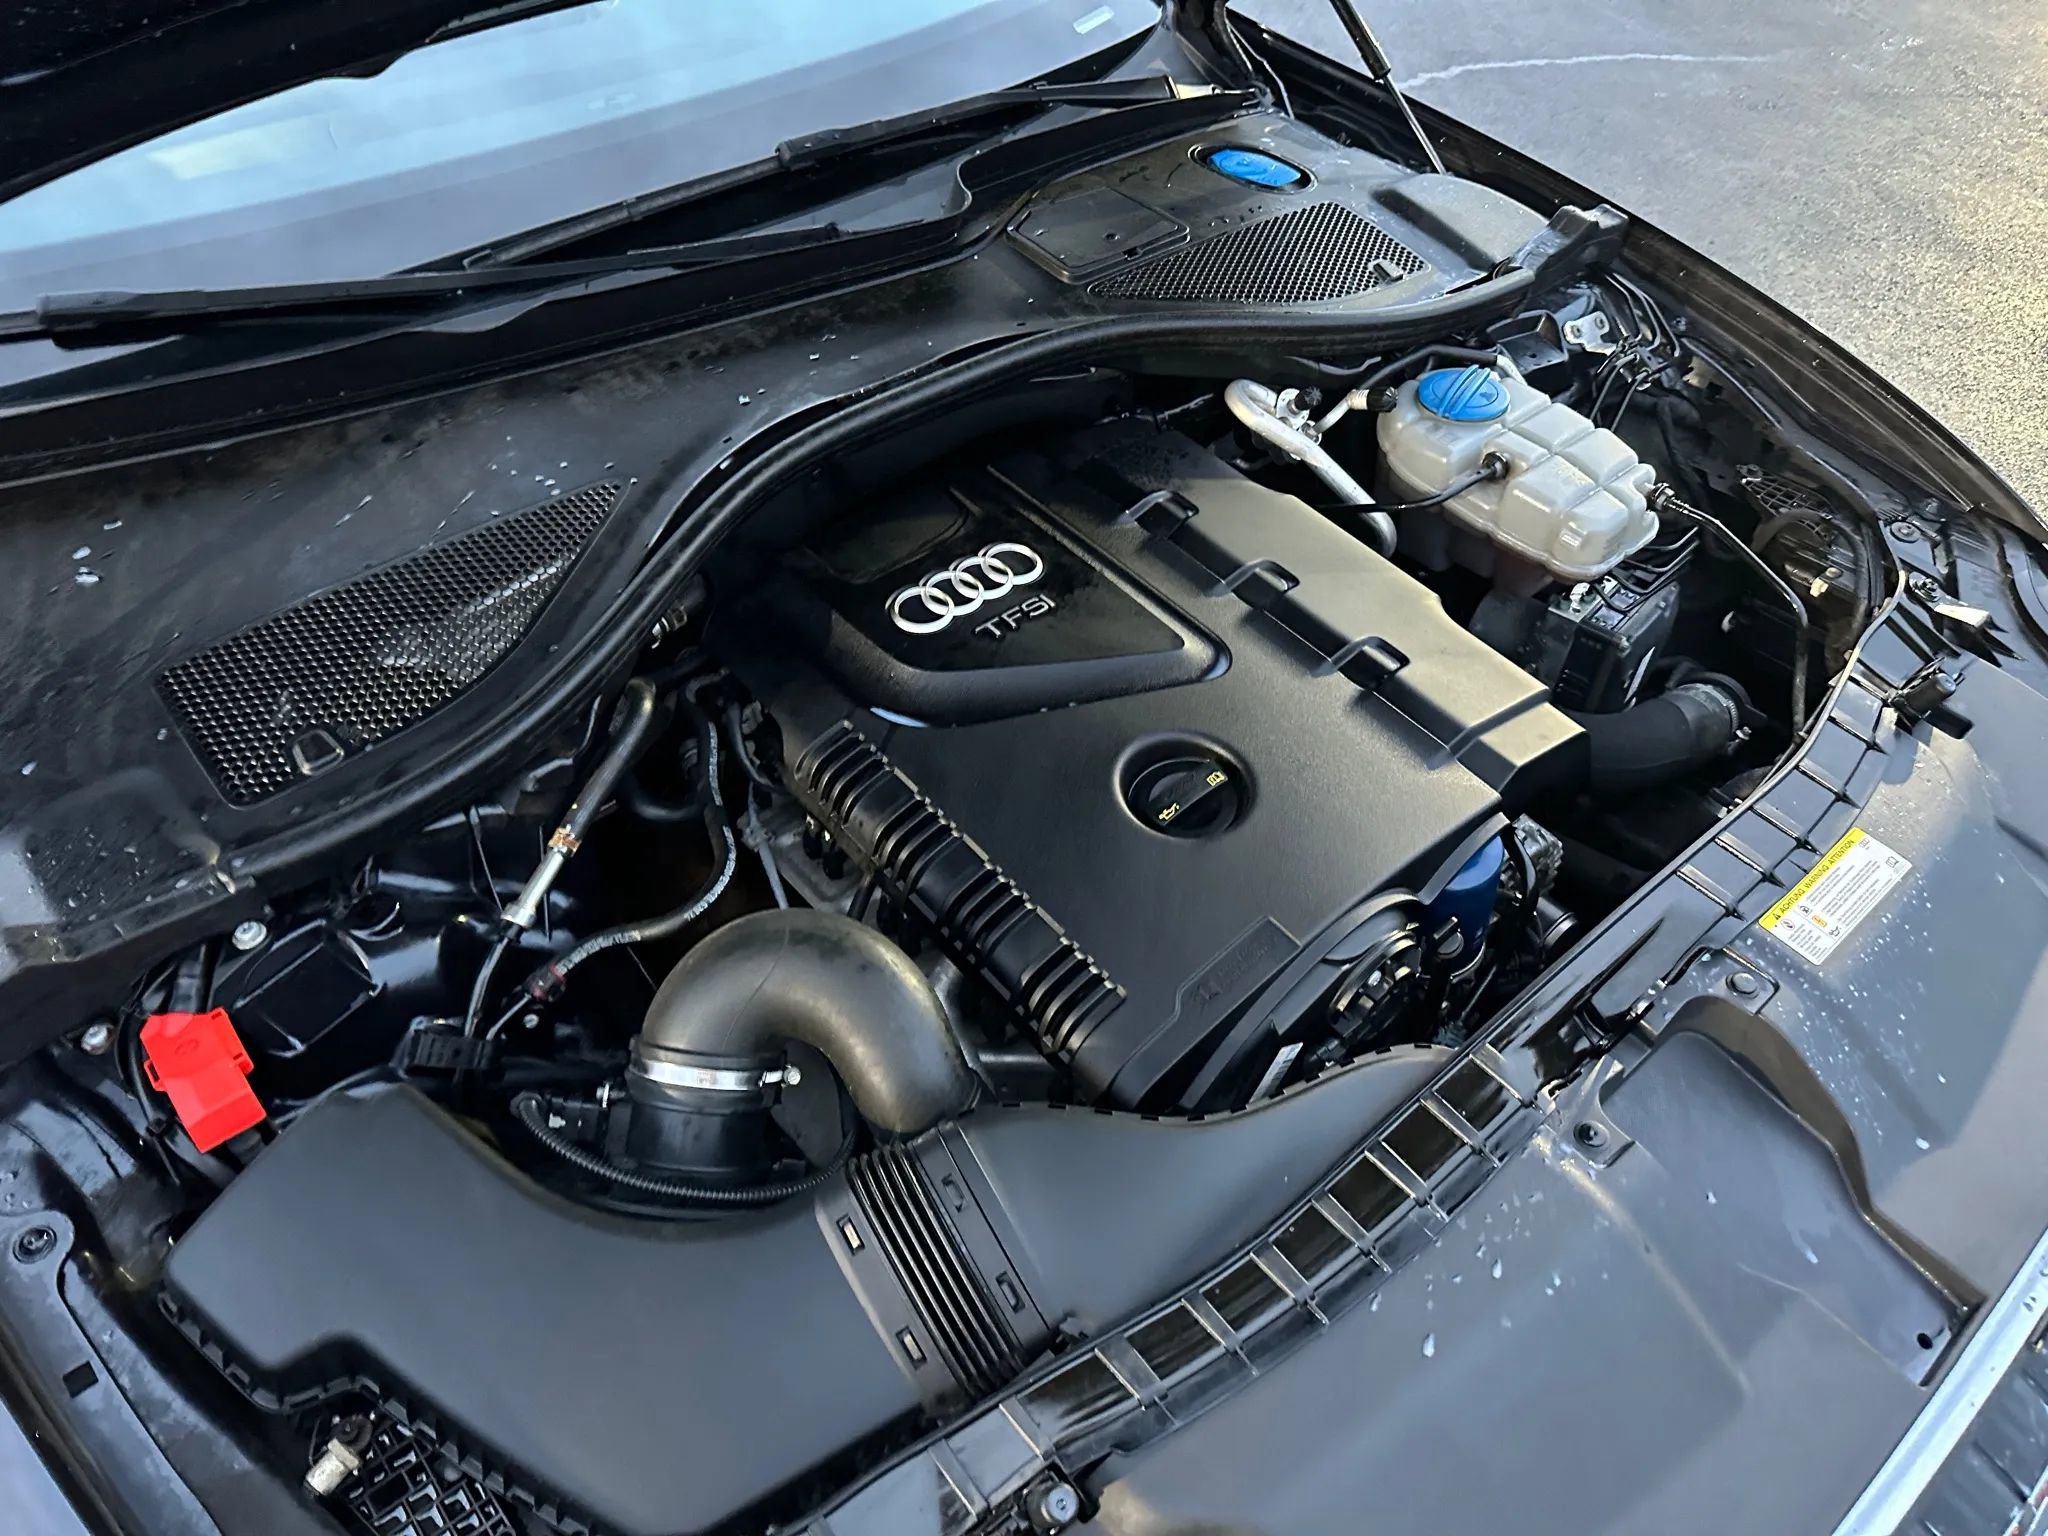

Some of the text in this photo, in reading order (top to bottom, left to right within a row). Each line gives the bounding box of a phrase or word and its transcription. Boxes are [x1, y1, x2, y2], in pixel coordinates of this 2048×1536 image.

[975, 594, 1056, 638] TFSI
[1780, 888, 1805, 914] ACHTUNG
[1804, 864, 1830, 889] WARNING
[1828, 840, 1855, 866] ATTENTION
